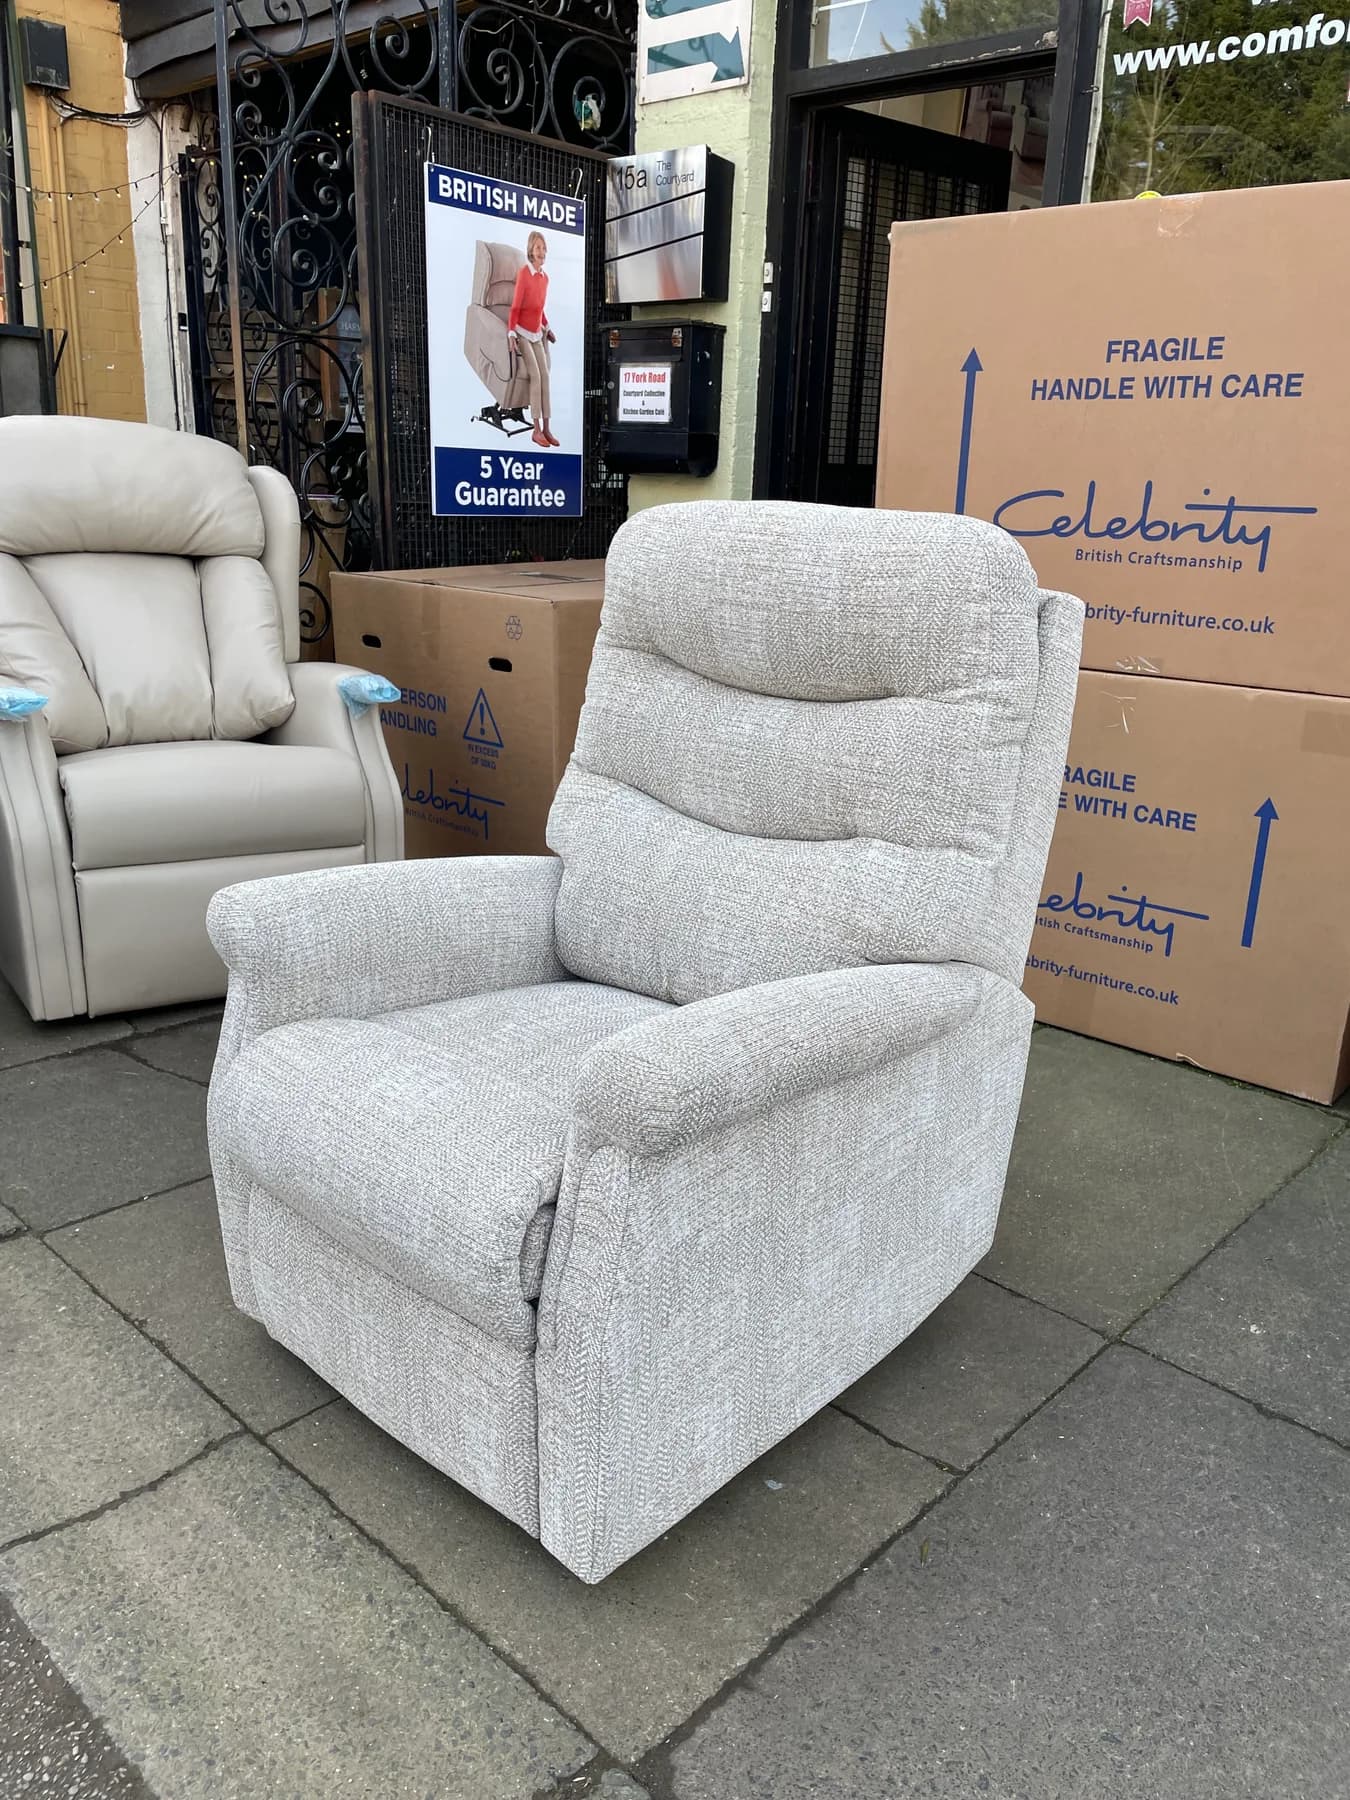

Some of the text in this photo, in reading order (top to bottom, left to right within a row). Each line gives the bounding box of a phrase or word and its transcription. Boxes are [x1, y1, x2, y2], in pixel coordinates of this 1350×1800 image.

[1113, 13, 1350, 76] www.comfo
[616, 164, 648, 191] 15a
[655, 170, 695, 186] Courtyard
[656, 160, 672, 172] The
[438, 174, 577, 227] BRITISH MADE
[1105, 336, 1226, 363] FRAGILE
[624, 372, 665, 383] 17 York Road
[1031, 373, 1305, 401] HANDLE WITH CARE
[480, 455, 544, 480] 5 Year
[454, 481, 566, 507] Guarantee
[993, 480, 1318, 573] Celebrity
[1075, 548, 1243, 573] British Craftsmanship
[1085, 602, 1276, 634] brity-furniture.co.uk
[401, 687, 447, 713] ERSON
[380, 709, 437, 736] ANDLING
[1064, 764, 1137, 792] RAGILE
[402, 763, 506, 840] lebrity
[1074, 793, 1127, 819] WITH
[1133, 804, 1197, 832] CARE
[1037, 871, 1210, 957] ebrity
[1035, 915, 1154, 954] itish Craftsmanship
[1025, 954, 1180, 1005] ebrity-furniture.co.uk
